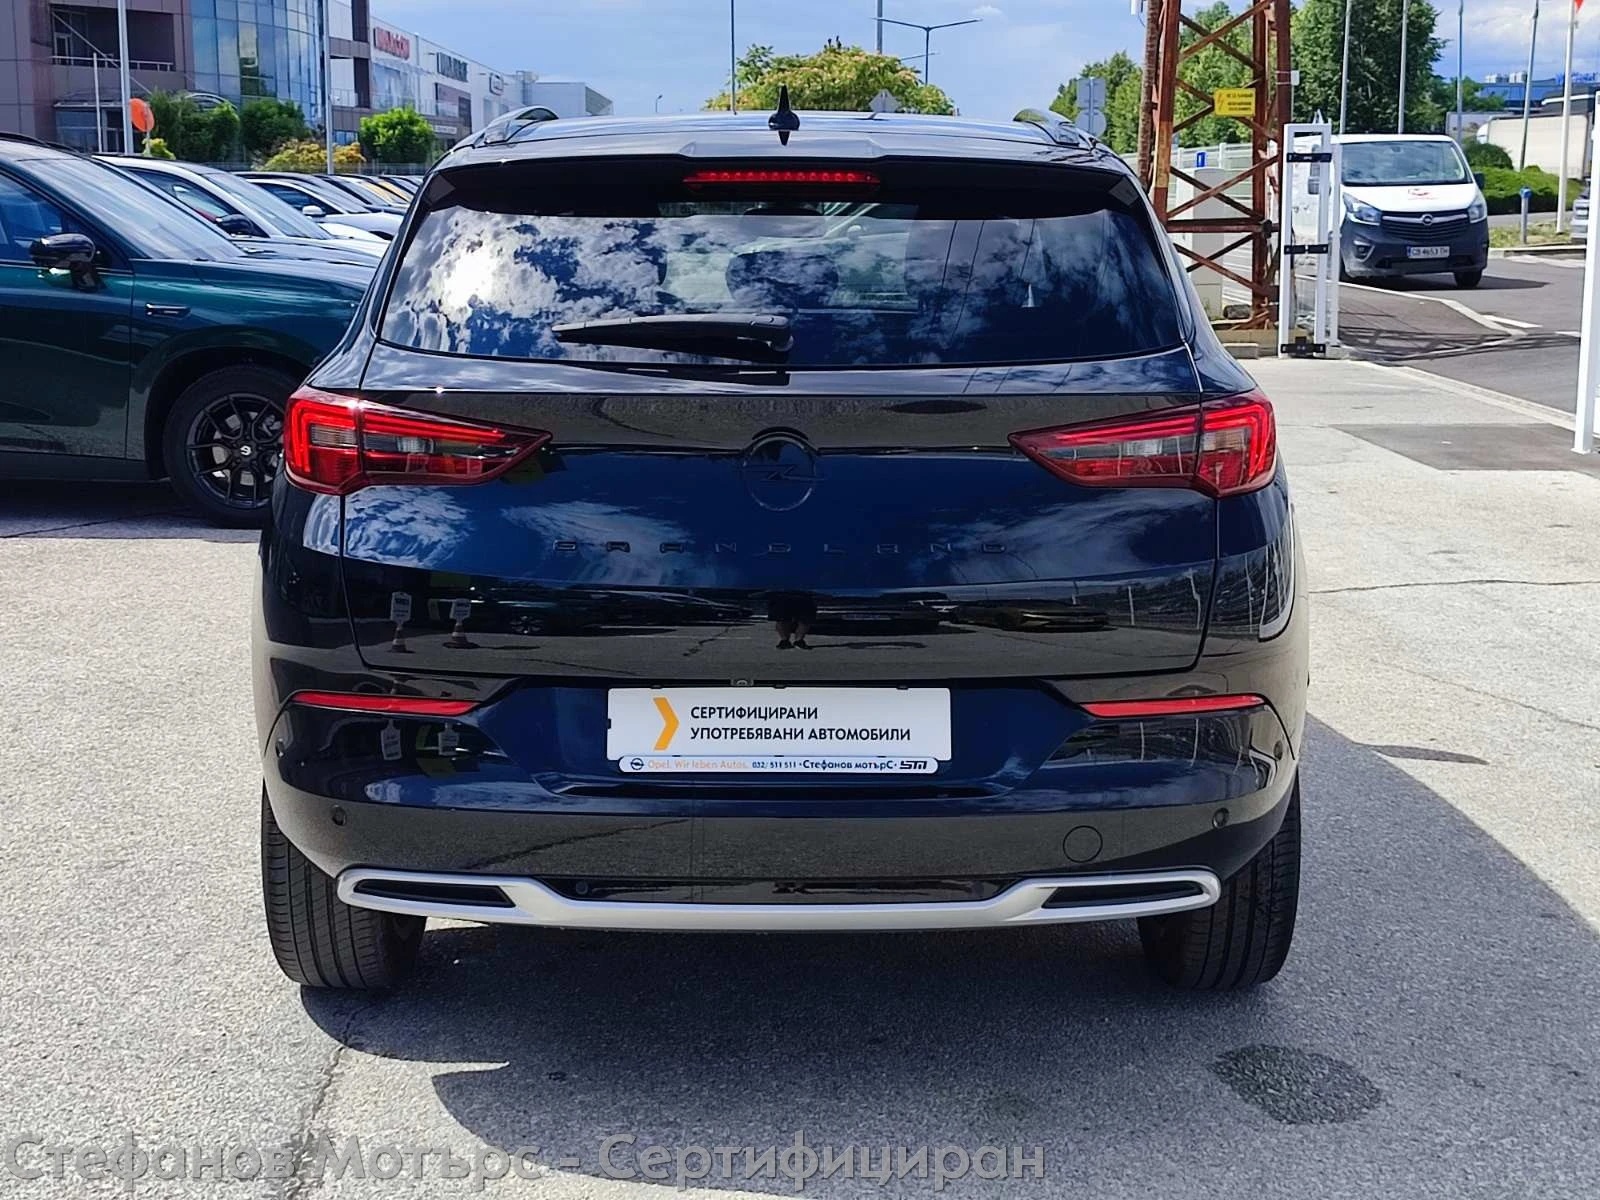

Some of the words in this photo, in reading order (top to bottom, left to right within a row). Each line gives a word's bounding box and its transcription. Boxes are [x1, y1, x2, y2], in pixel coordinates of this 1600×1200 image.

[553, 540, 1006, 554] GRANDLAND
[690, 706, 818, 721] СЕРТИФИЦИРАНИ
[690, 726, 804, 741] УПОТРЕБЯВАНИ
[808, 726, 911, 741] АВТОМОБИЛИ
[674, 760, 689, 769] Wir
[692, 760, 718, 769] leben
[770, 760, 782, 769] 511
[784, 760, 797, 769] 511
